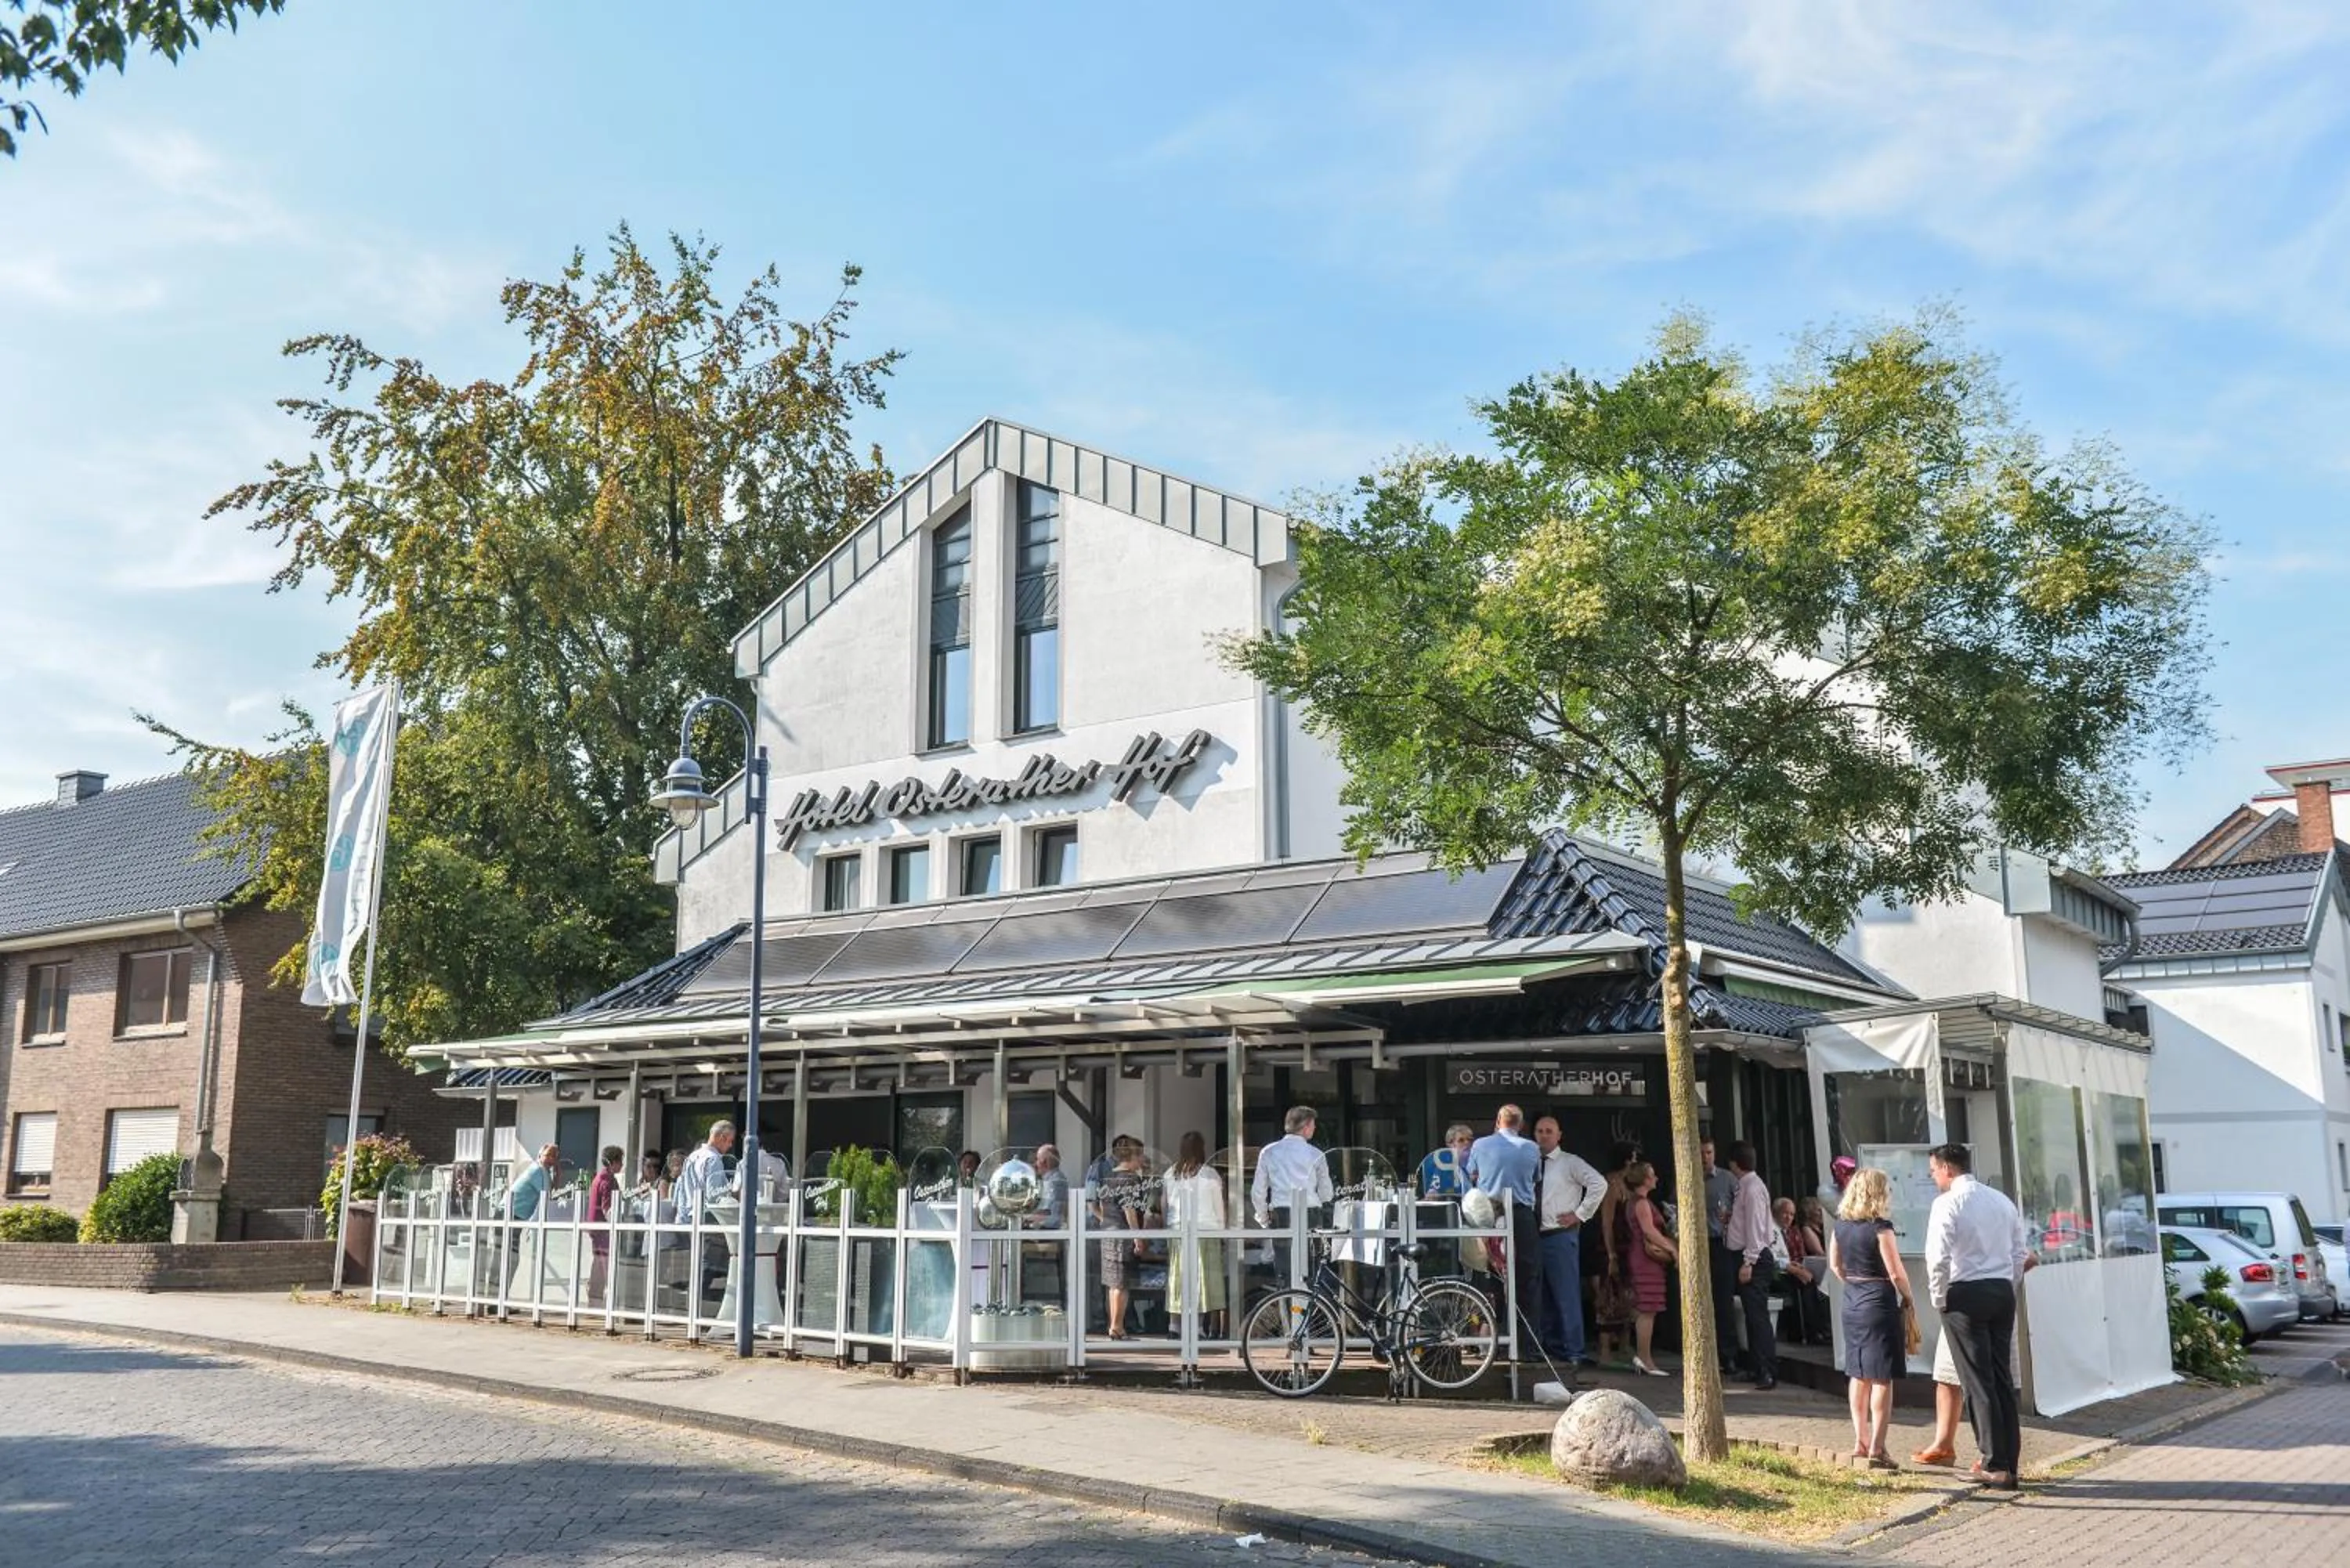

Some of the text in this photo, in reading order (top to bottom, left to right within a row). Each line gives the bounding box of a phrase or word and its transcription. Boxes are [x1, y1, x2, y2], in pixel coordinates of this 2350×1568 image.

[775, 728, 1212, 851] Hotel Osterather Hof
[1459, 1069, 1632, 1086] OSTERATHERHOF
